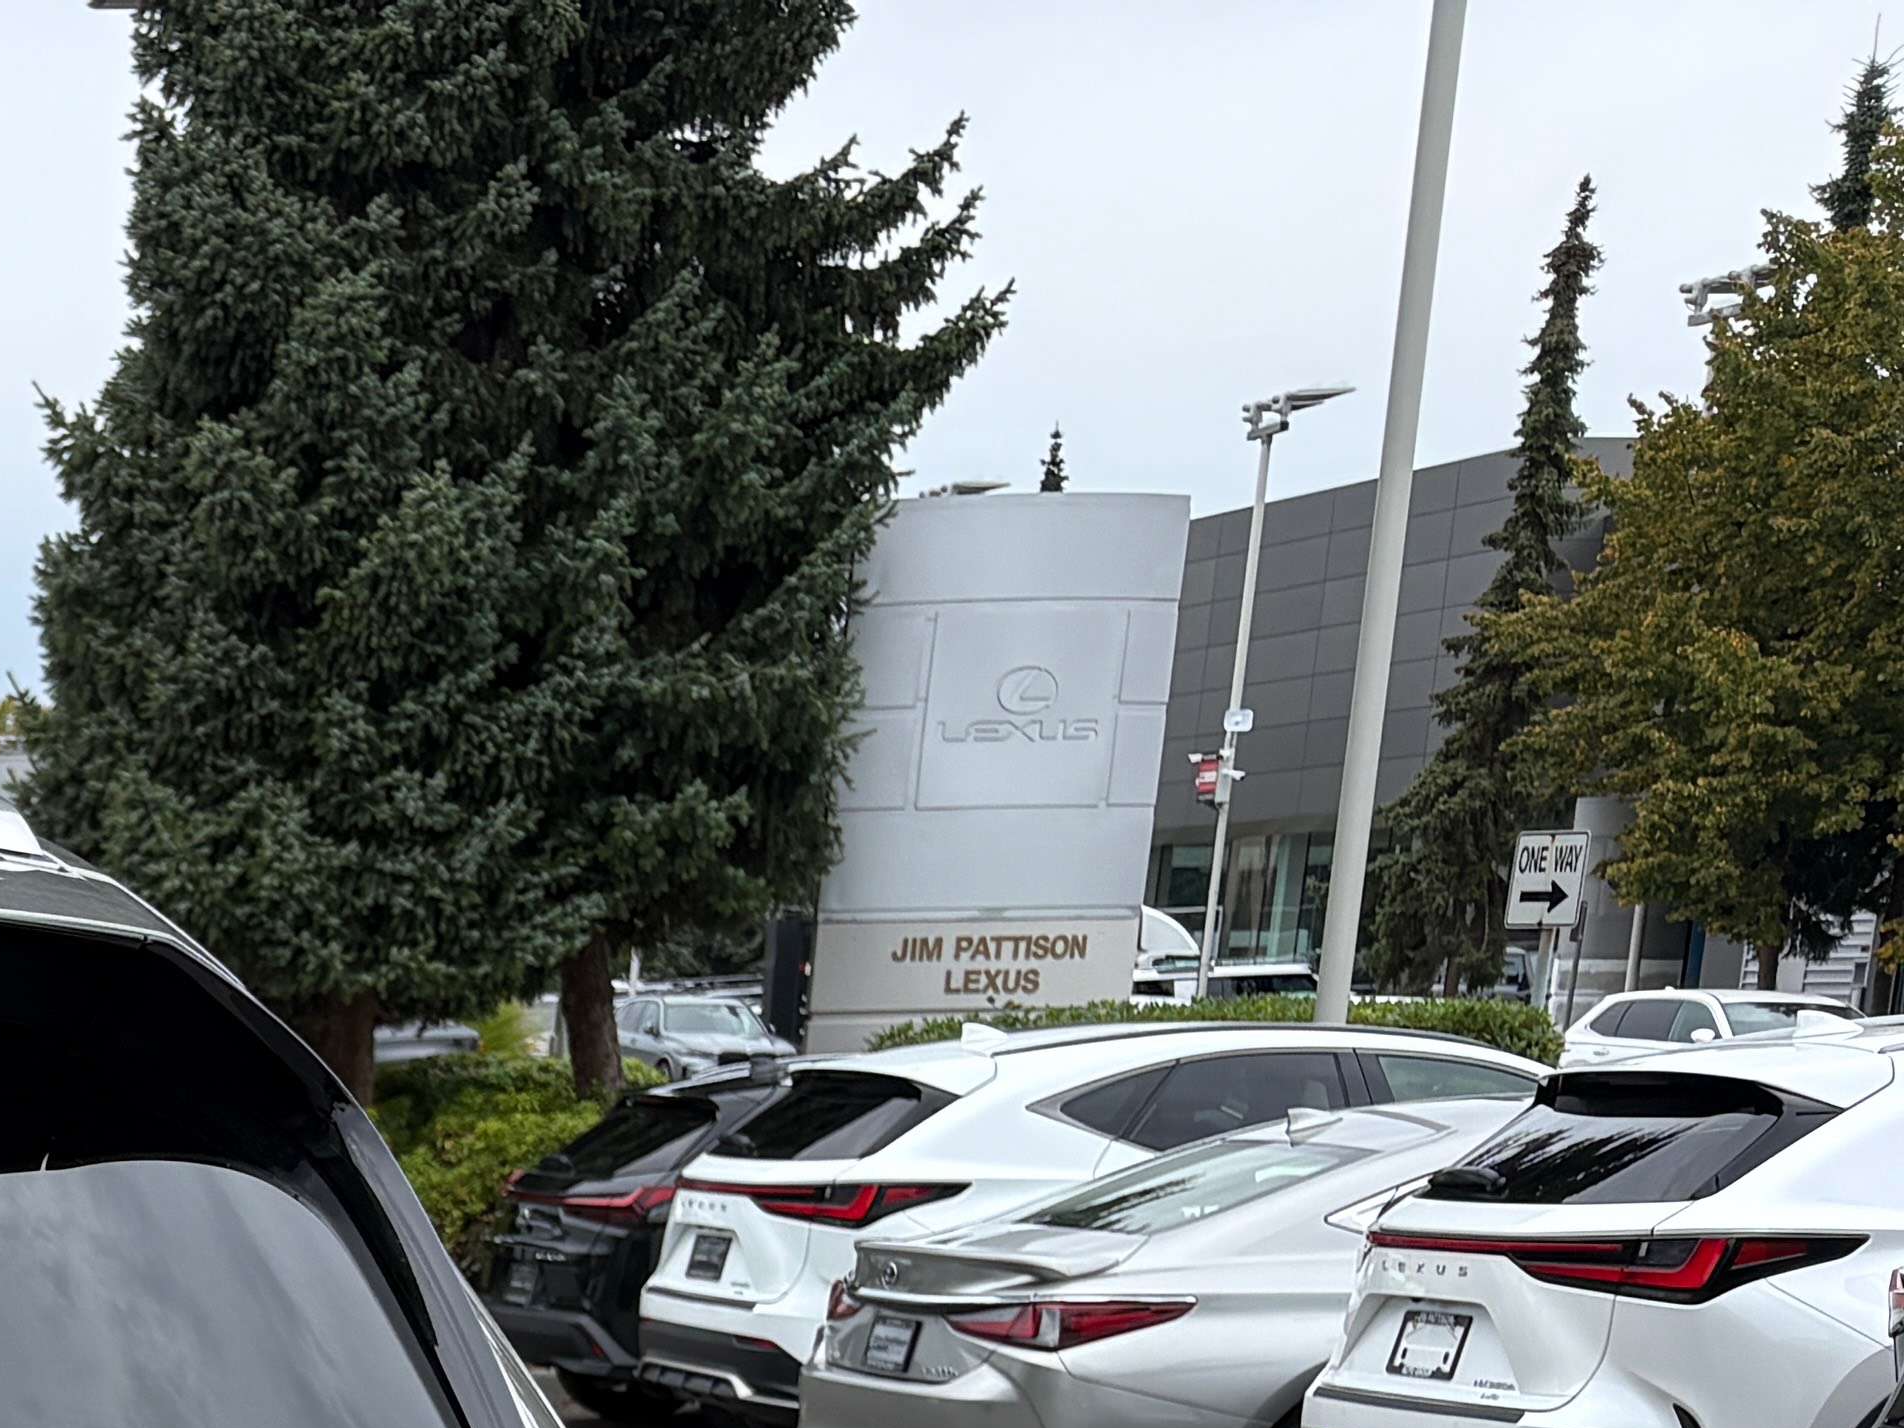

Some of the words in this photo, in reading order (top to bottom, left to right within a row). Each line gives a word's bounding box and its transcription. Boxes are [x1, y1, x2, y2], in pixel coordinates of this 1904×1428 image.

[938, 719, 1098, 743] LEXUS
[1518, 845, 1549, 874] ONE
[1553, 844, 1584, 873] WAY
[892, 937, 944, 962] JIM
[953, 934, 1088, 962] PATTISON
[944, 969, 1040, 995] LEXUS
[1382, 1259, 1469, 1278] LEXUS
